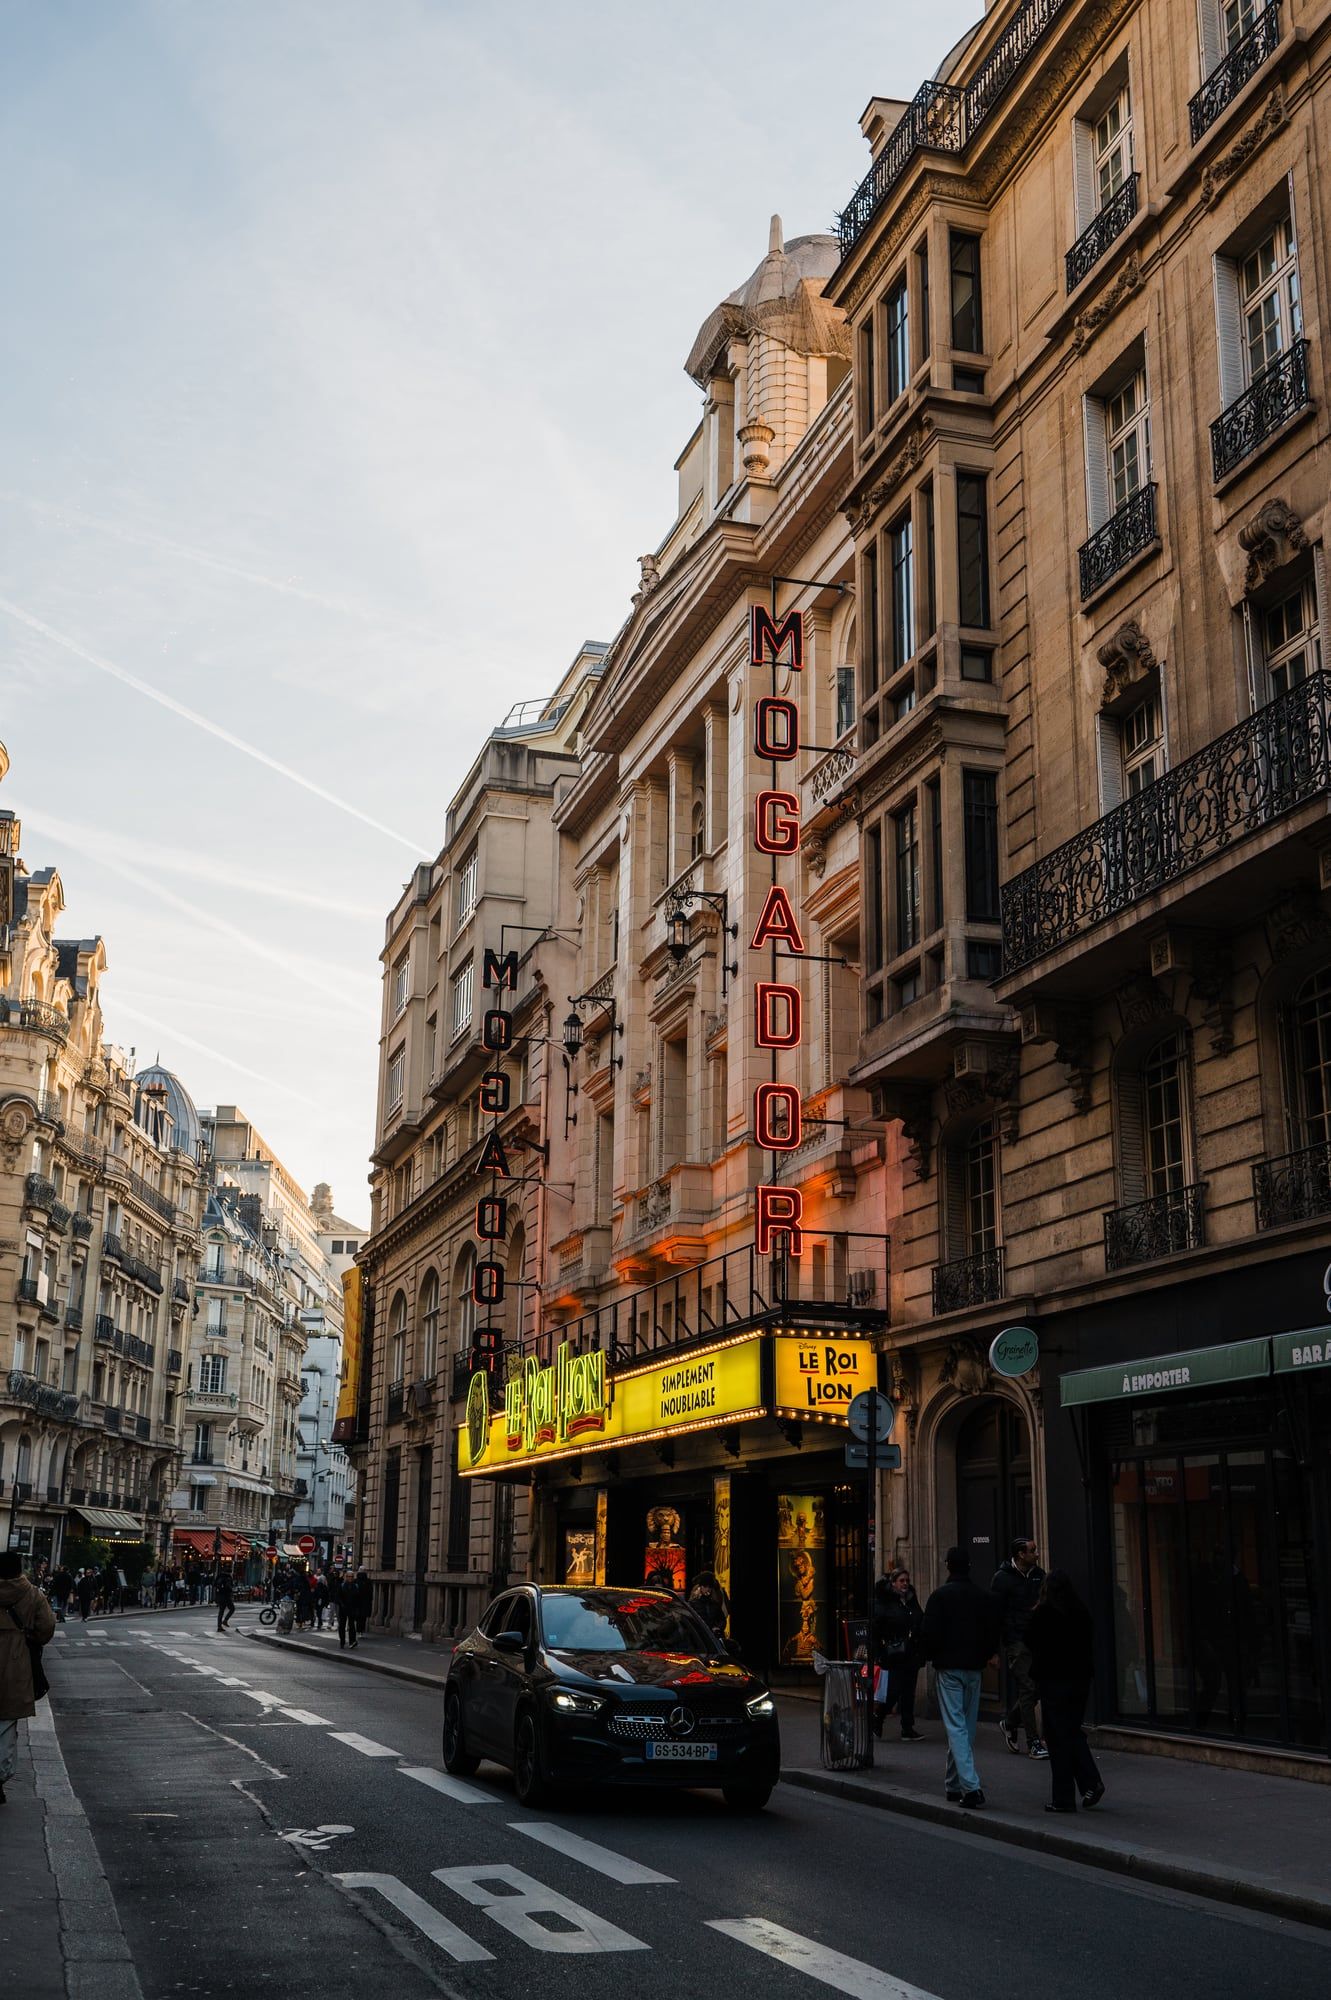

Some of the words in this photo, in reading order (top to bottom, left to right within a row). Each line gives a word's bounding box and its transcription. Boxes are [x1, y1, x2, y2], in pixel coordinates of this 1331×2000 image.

[749, 604, 805, 1256] MOGADOR
[799, 1352, 819, 1369] LE
[1292, 1344, 1322, 1365] BAR
[662, 1362, 714, 1394] SIMPLEMENT
[1122, 1374, 1131, 1393] À
[1131, 1367, 1190, 1392] EMPORTER
[505, 1379, 523, 1436] LE
[661, 1387, 715, 1418] INOUBLIABLE
[655, 1745, 709, 1757] GS-534-BP
